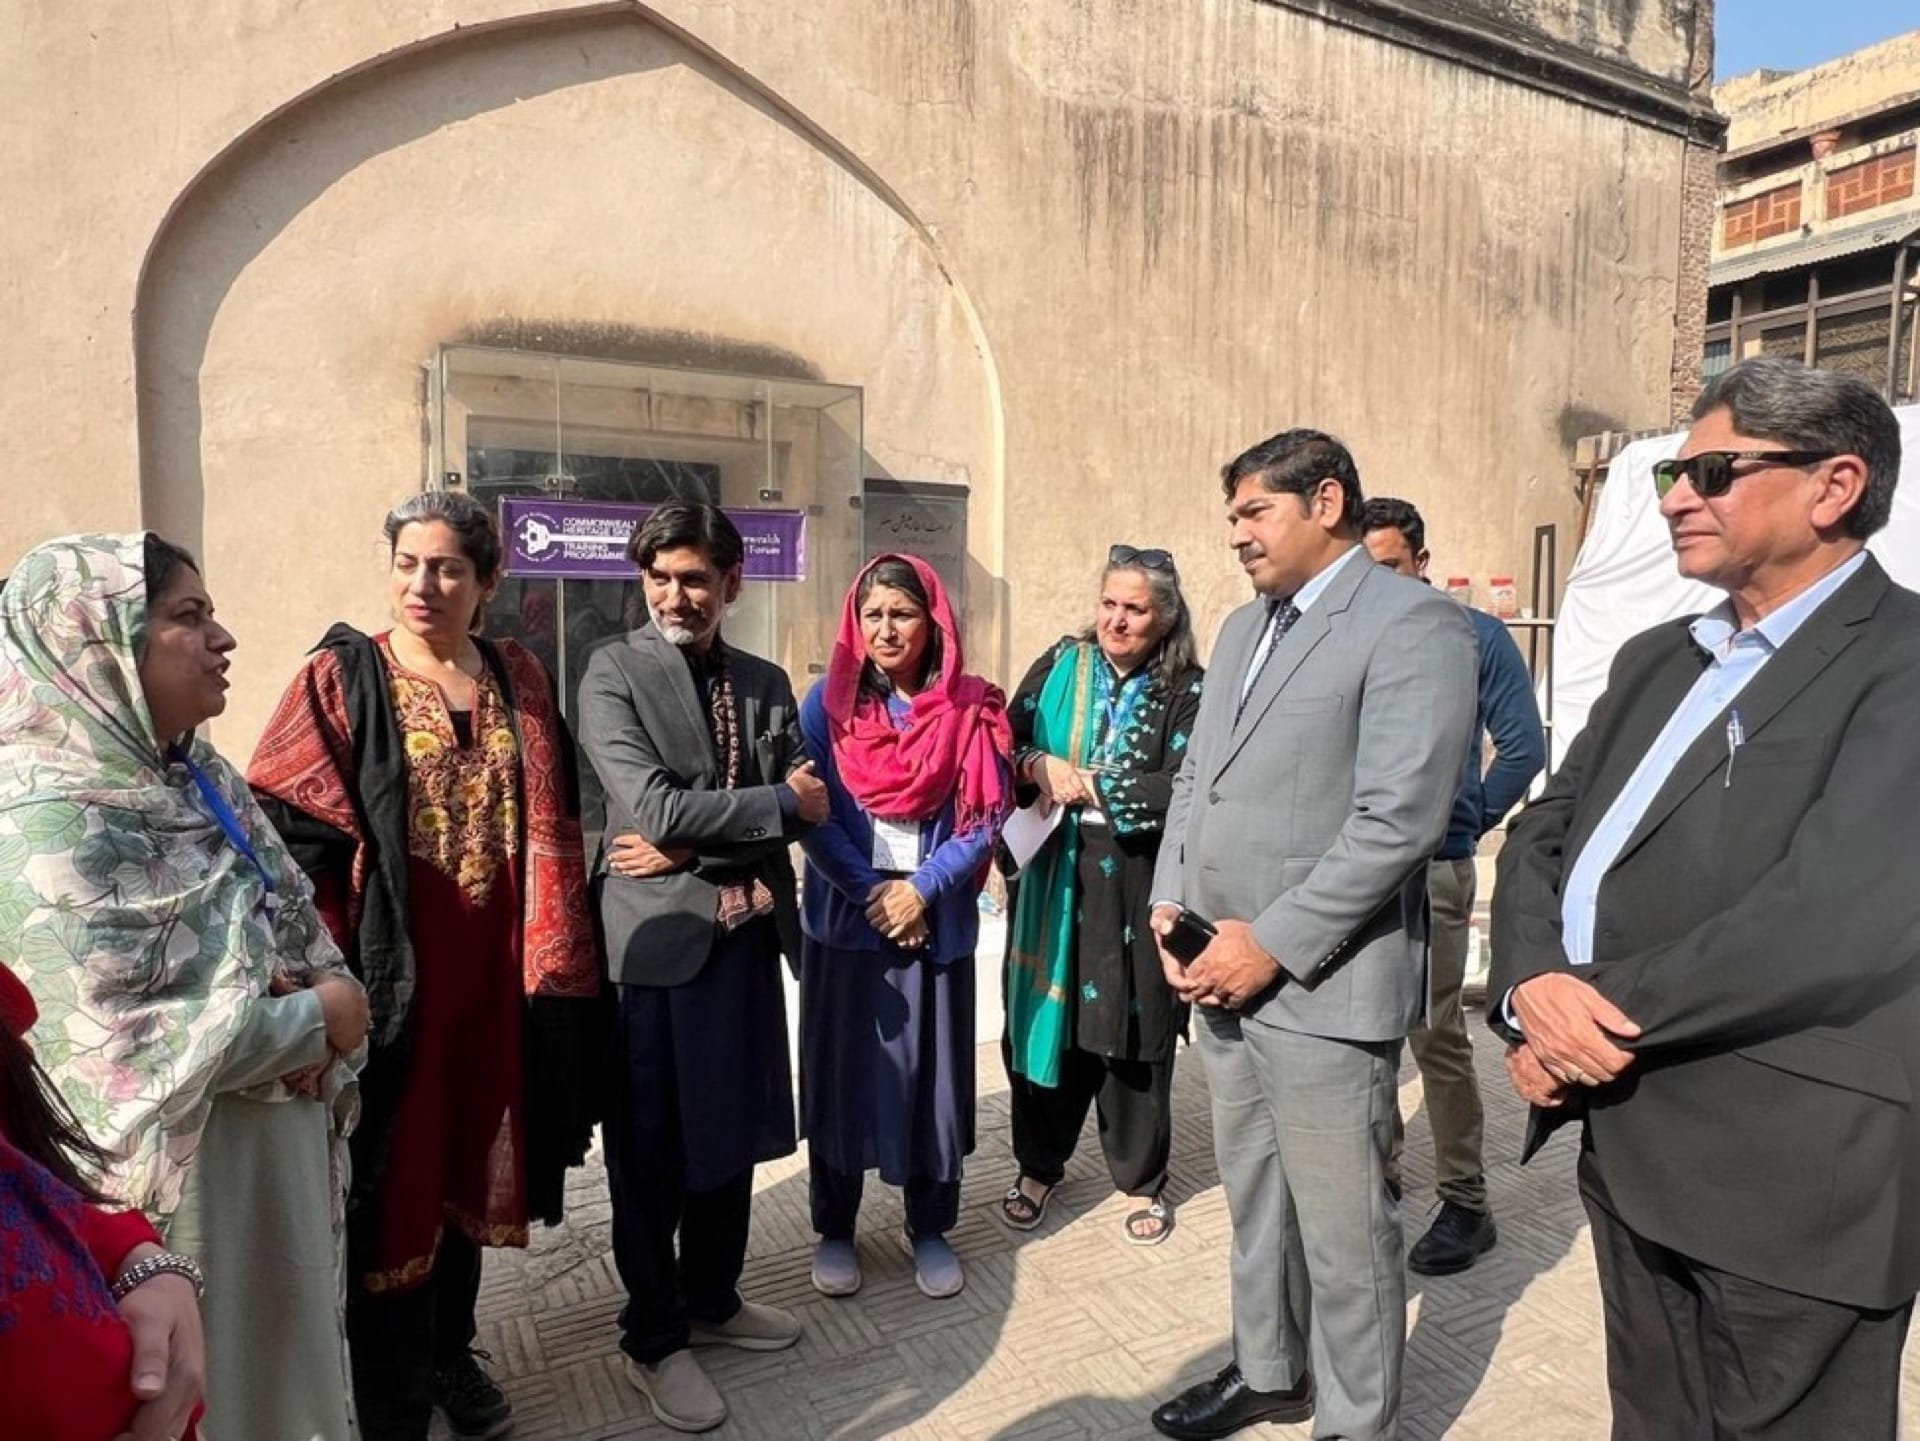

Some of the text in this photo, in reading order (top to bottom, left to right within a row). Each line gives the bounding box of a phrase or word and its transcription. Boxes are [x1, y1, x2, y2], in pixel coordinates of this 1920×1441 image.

[563, 518, 637, 529] COMMONWEALT
[563, 526, 610, 536] HERITAGE
[563, 542, 609, 551] TRAINING
[563, 550, 626, 560] PROGRAMME
